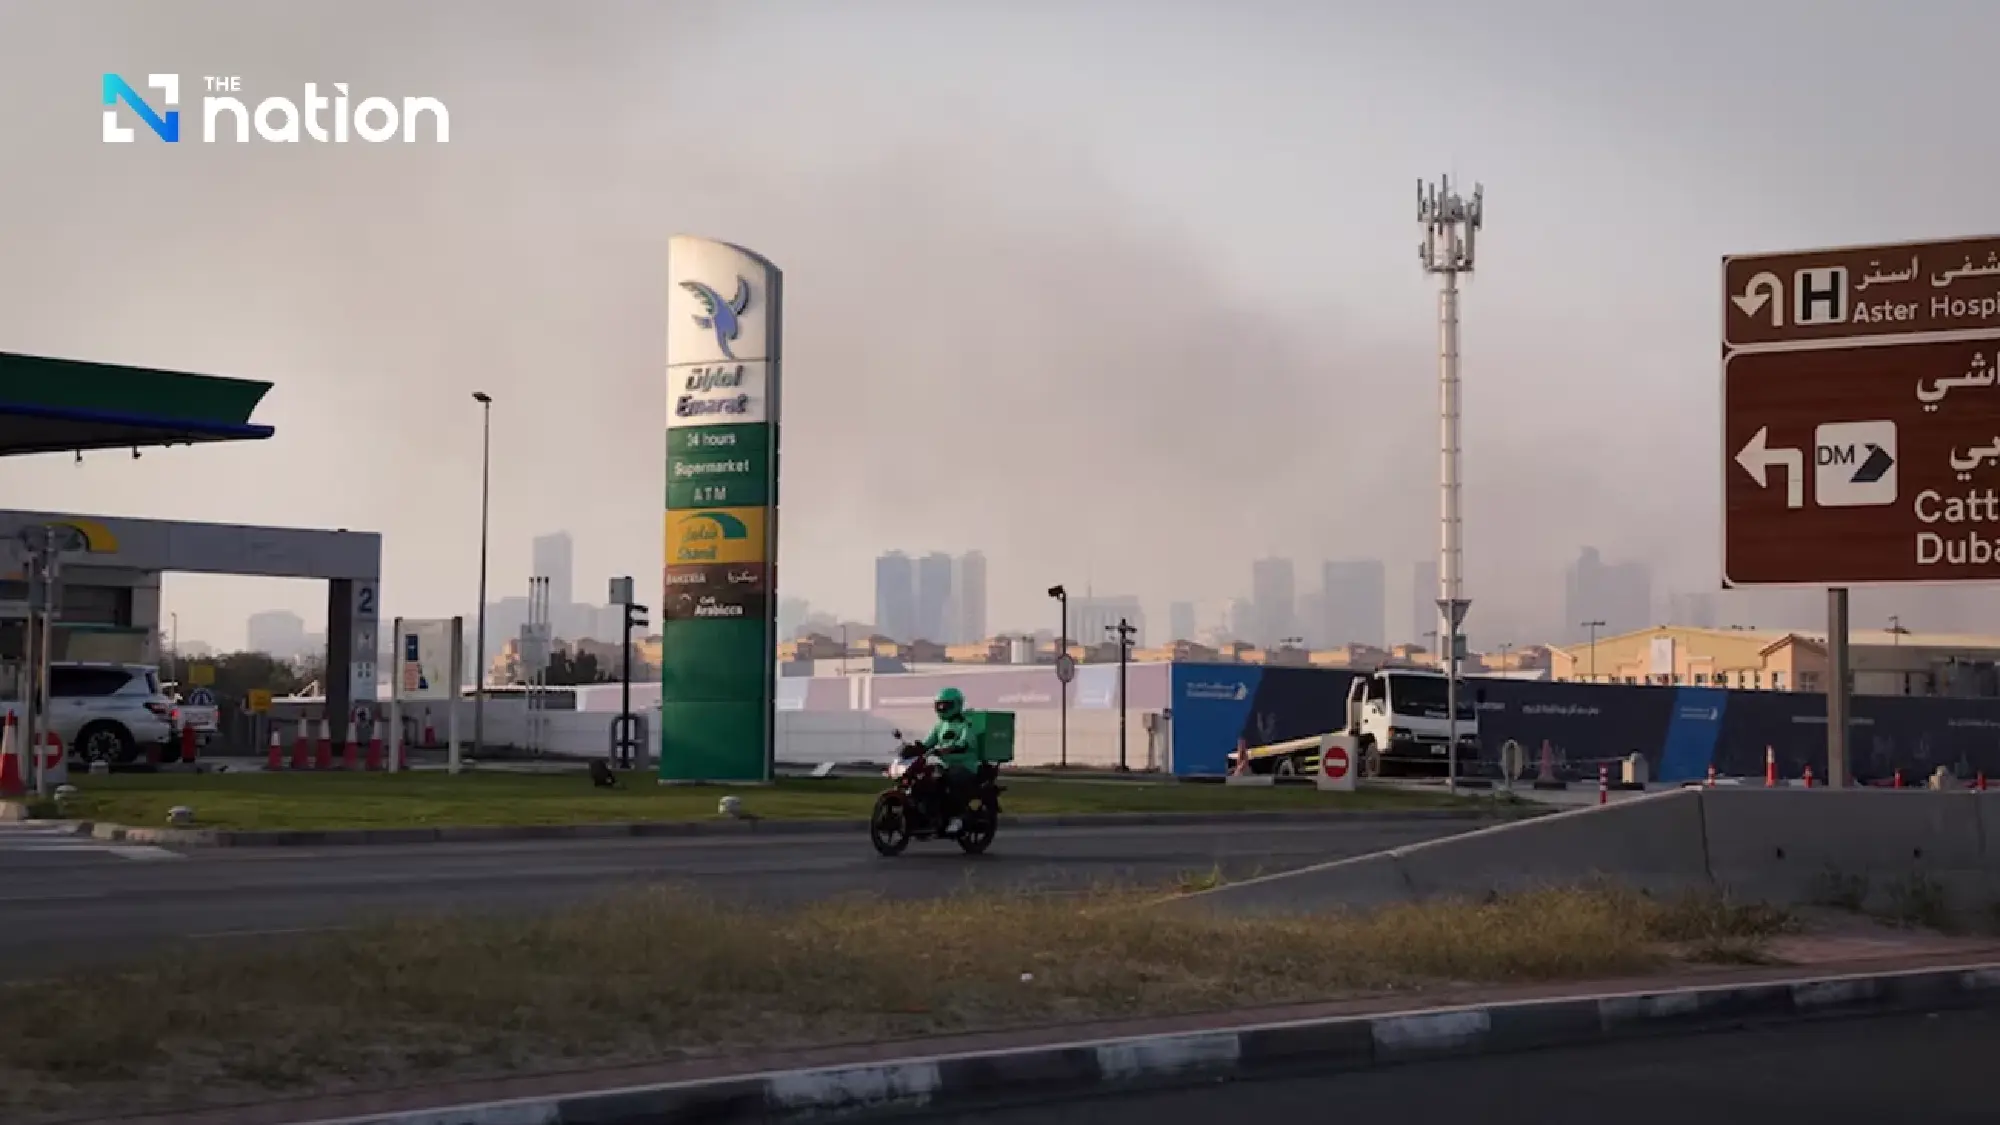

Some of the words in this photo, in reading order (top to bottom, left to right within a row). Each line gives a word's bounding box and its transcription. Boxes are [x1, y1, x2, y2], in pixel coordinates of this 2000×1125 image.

[1852, 300, 1918, 323] Aster
[676, 394, 748, 416] Emarat
[703, 432, 736, 446] hours
[1818, 445, 1855, 465] DM
[674, 459, 749, 477] Supermarket
[1915, 488, 1999, 523] Catt
[358, 587, 373, 614] 2
